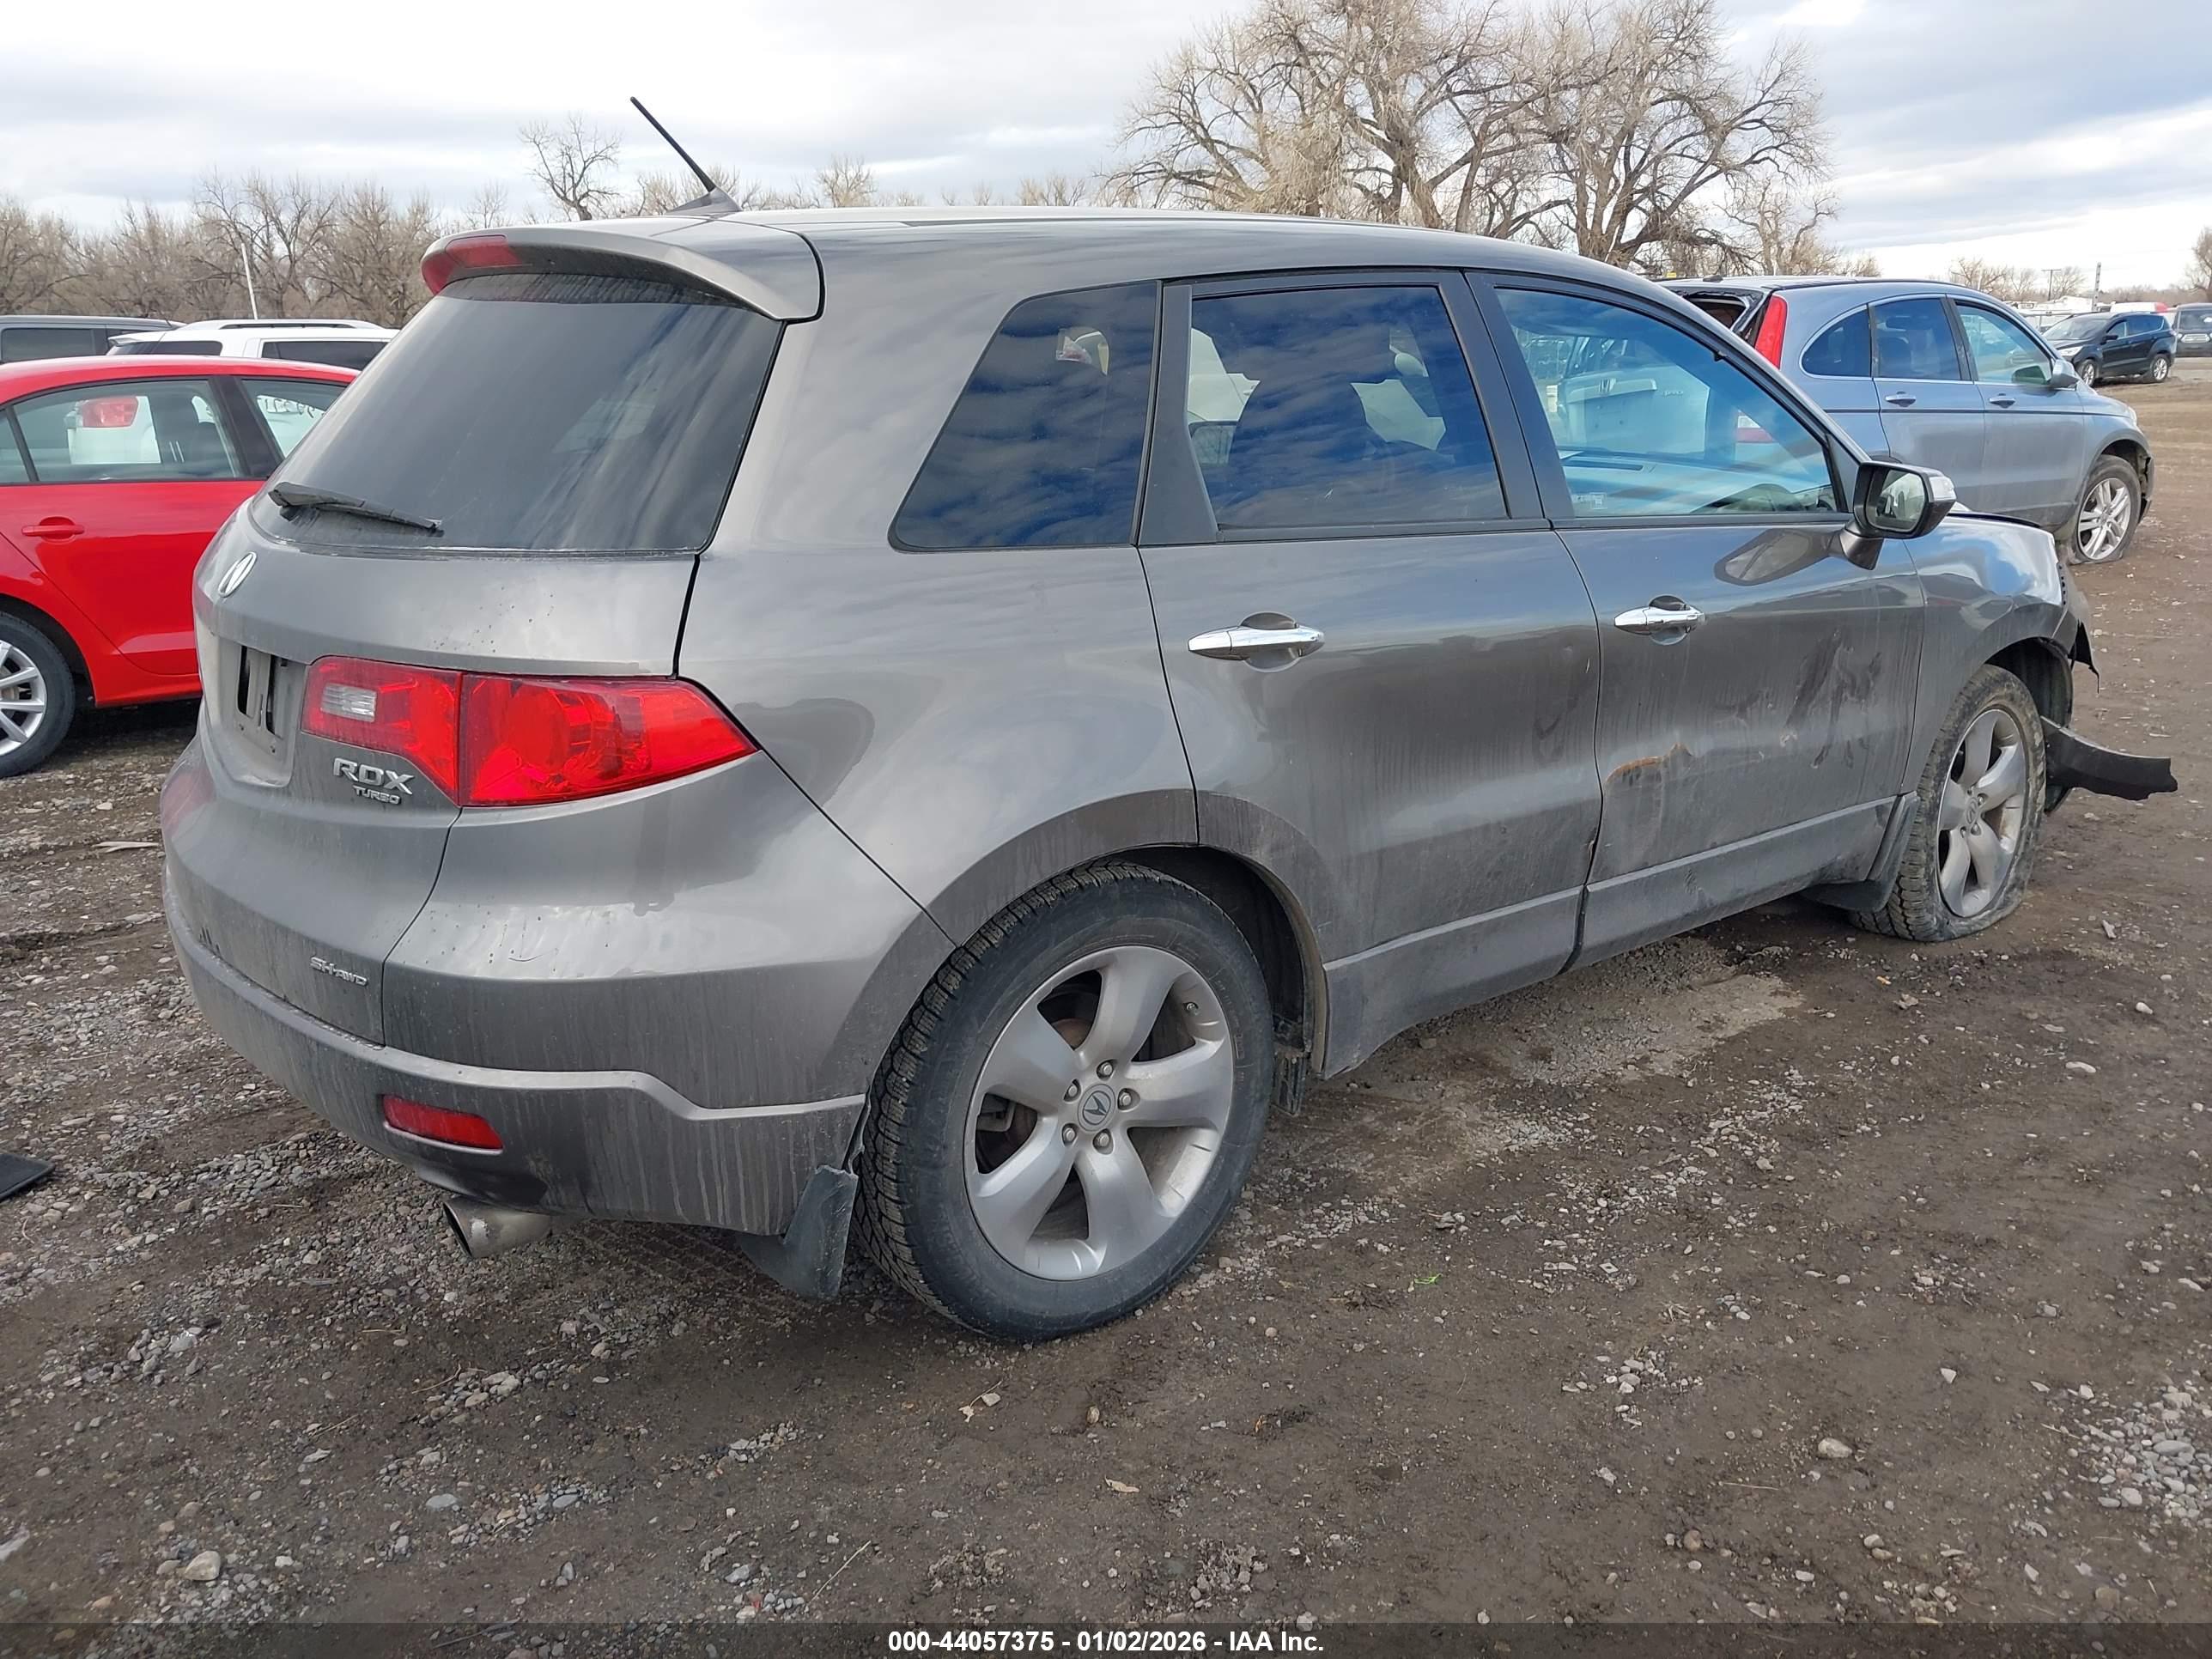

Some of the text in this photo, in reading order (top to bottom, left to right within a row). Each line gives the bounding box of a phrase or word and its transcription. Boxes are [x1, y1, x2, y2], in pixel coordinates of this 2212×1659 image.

[332, 757, 415, 795] RDX
[351, 784, 402, 805] TURBO
[309, 956, 368, 987] SH-AWD
